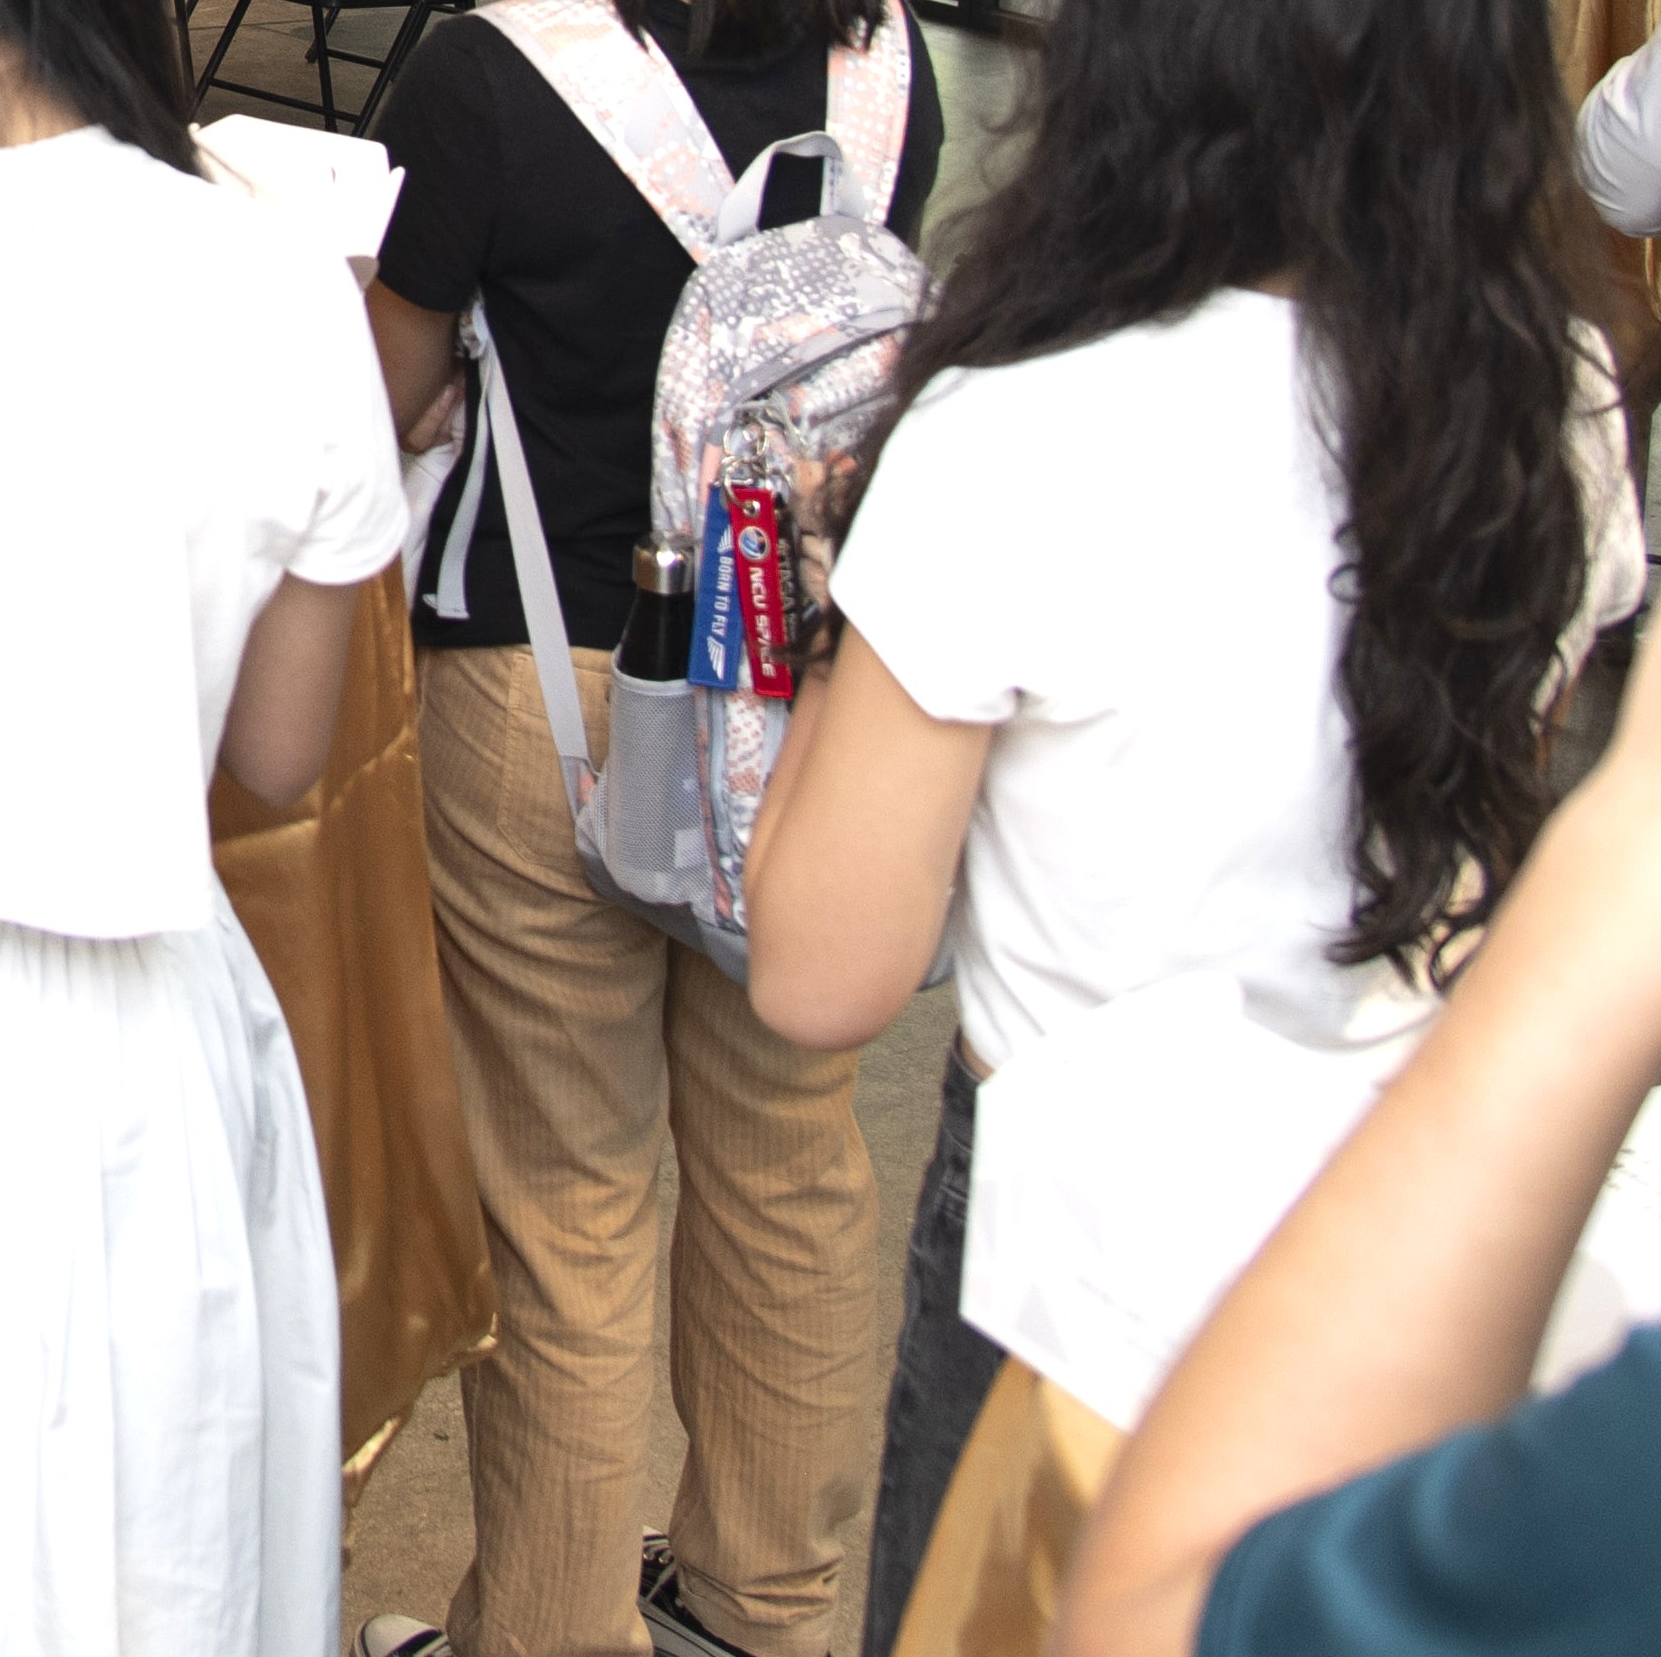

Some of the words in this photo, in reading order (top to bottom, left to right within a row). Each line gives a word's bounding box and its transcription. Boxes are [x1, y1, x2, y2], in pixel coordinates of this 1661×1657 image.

[716, 556, 733, 592] BORN
[749, 566, 767, 609] NCU
[714, 595, 730, 611] TO
[711, 613, 728, 637] FLY
